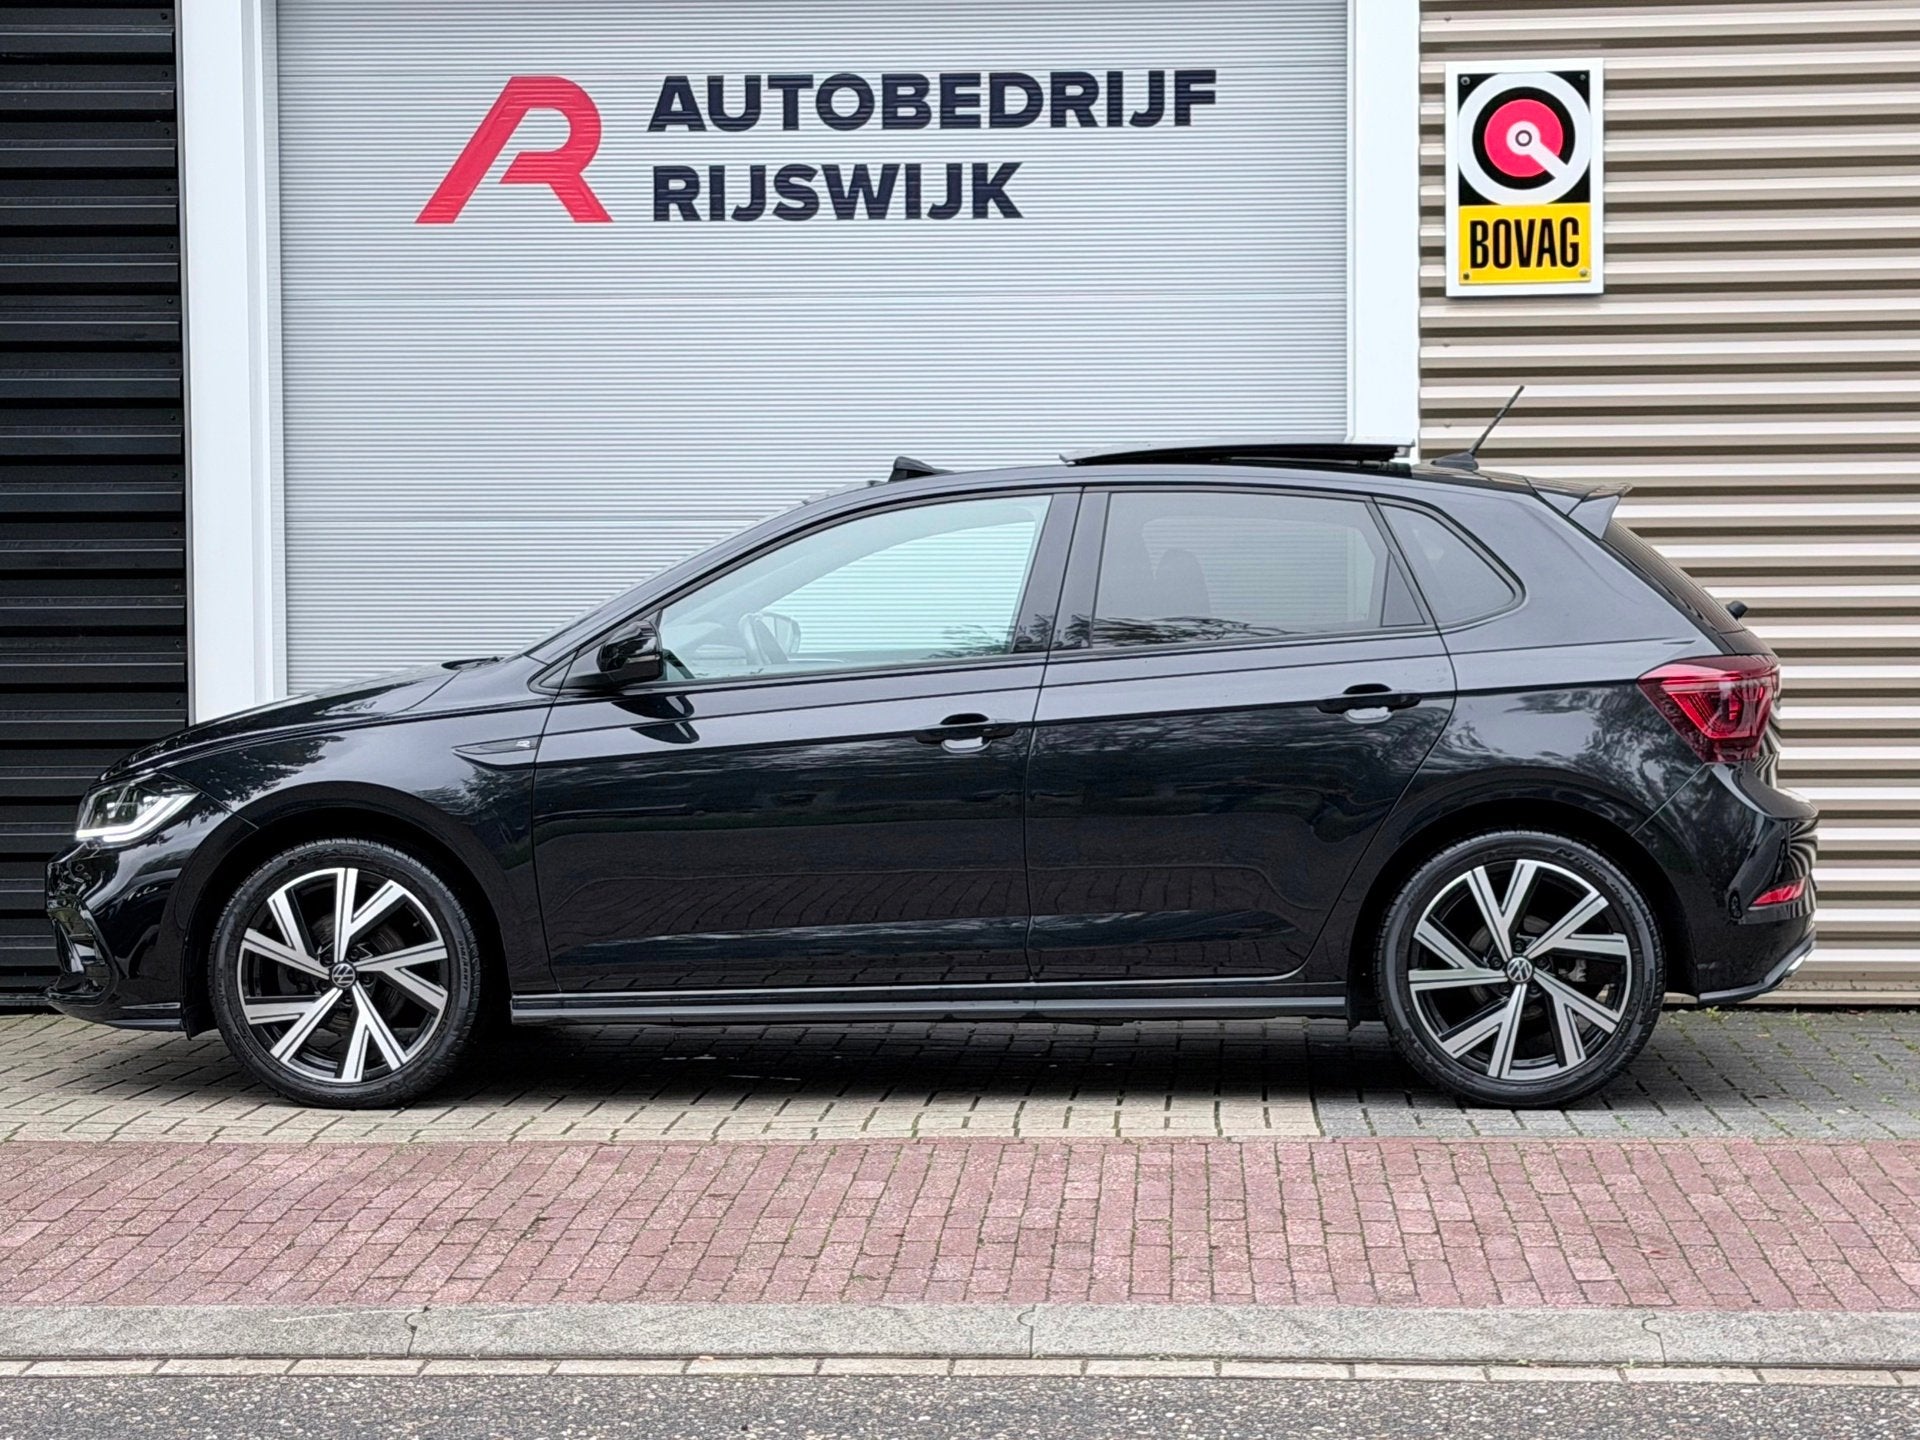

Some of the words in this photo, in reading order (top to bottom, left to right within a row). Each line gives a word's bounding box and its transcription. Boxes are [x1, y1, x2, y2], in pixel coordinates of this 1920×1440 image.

[647, 69, 1217, 132] AUTOBEDRIJF
[652, 162, 1023, 222] RIJSWIJK
[1470, 217, 1580, 269] BOVAG
